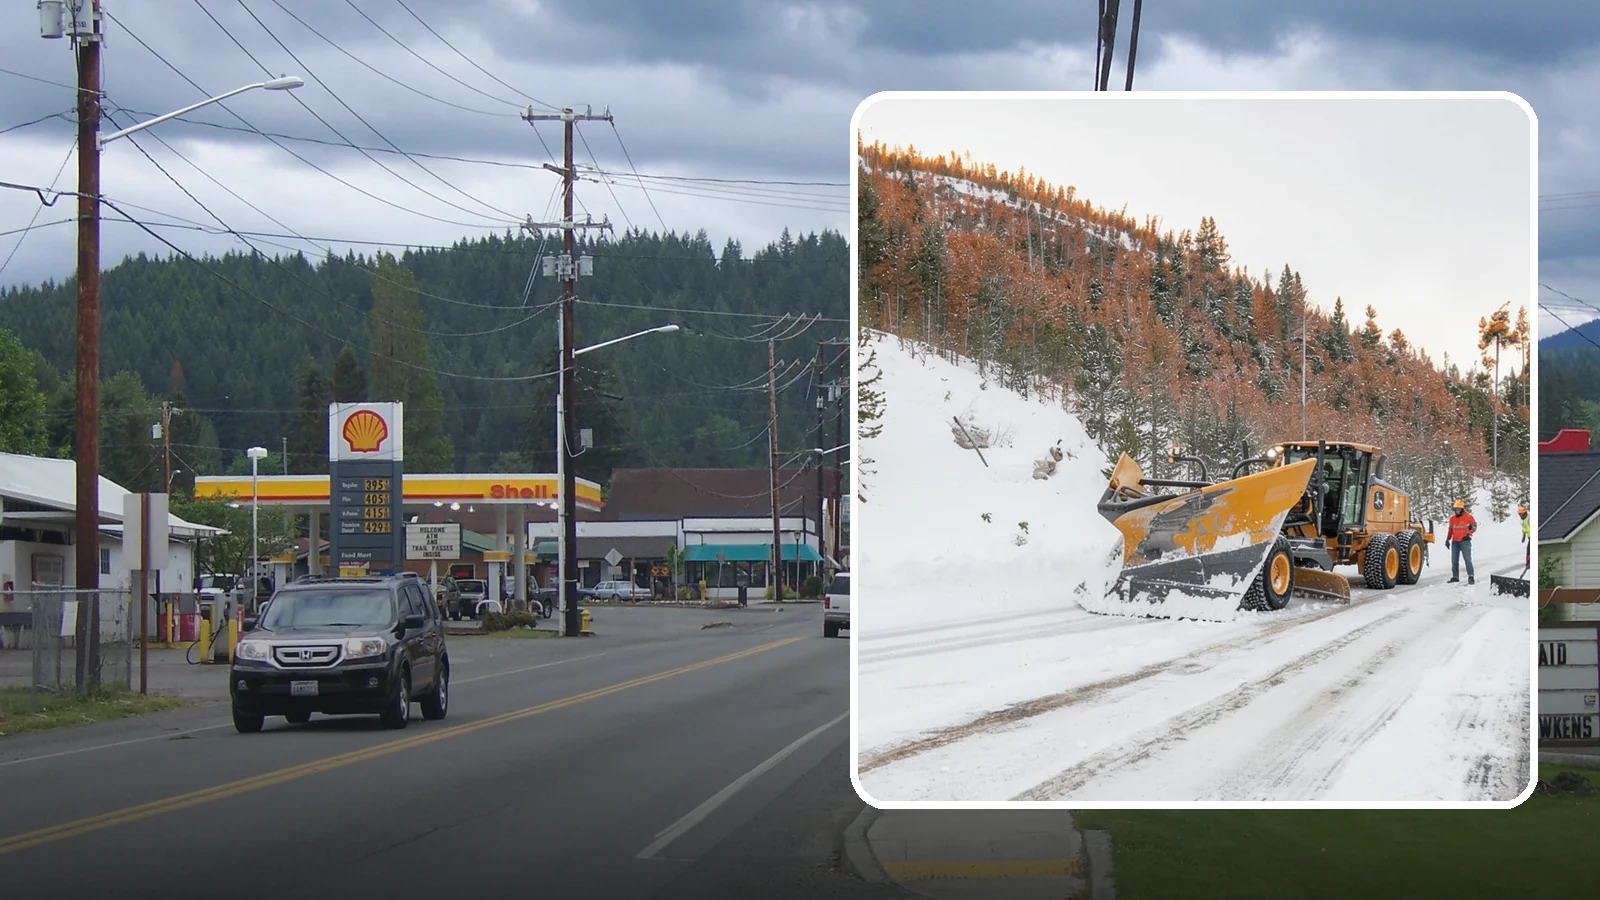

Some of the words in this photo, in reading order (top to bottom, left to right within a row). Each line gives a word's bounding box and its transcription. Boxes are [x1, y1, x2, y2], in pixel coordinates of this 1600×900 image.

[366, 480, 383, 490] 395
[490, 484, 547, 499] Shell
[366, 494, 383, 504] 405
[366, 508, 383, 517] 415
[366, 522, 383, 532] 429
